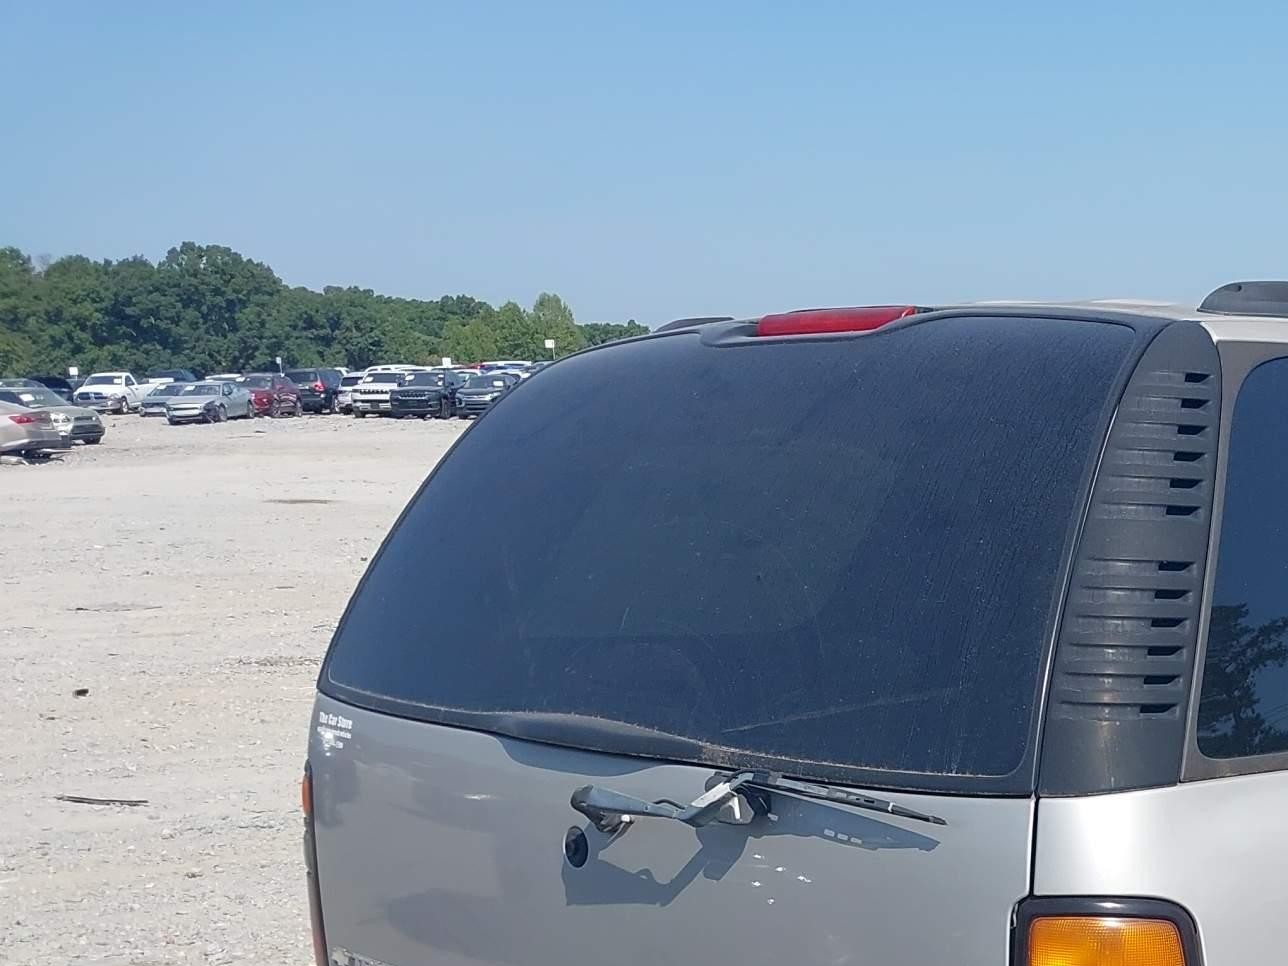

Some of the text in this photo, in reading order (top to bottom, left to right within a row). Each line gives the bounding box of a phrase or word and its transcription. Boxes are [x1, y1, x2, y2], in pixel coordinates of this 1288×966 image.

[319, 711, 353, 730] The Car Store
